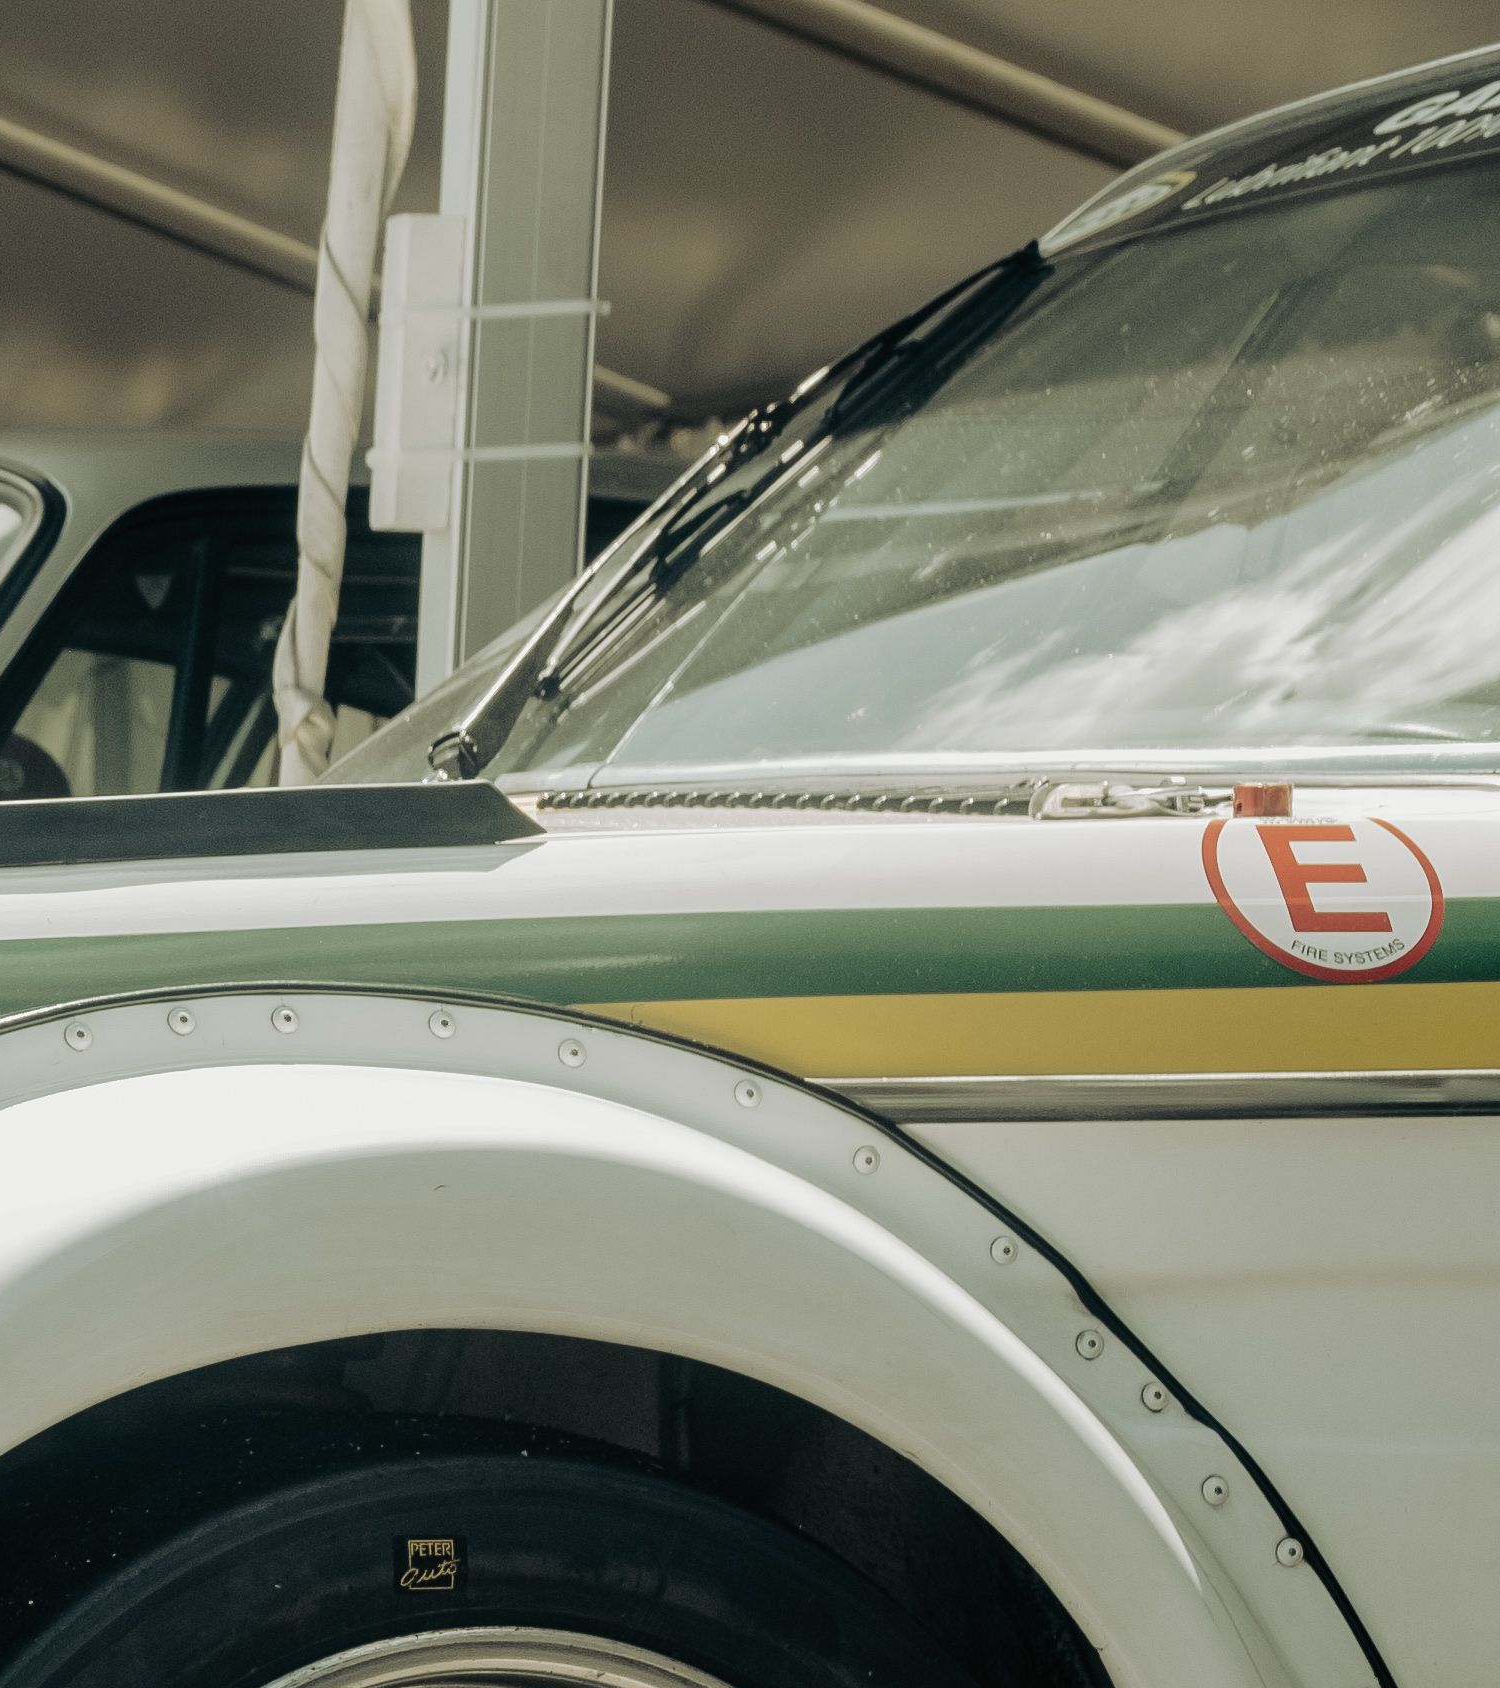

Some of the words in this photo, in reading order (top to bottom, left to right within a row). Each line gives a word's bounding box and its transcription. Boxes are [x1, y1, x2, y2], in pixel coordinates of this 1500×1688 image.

[1256, 825, 1393, 932] E
[1291, 939, 1328, 962] FIRE
[1333, 938, 1406, 965] SYSTEMS
[410, 1542, 452, 1556] PETER
